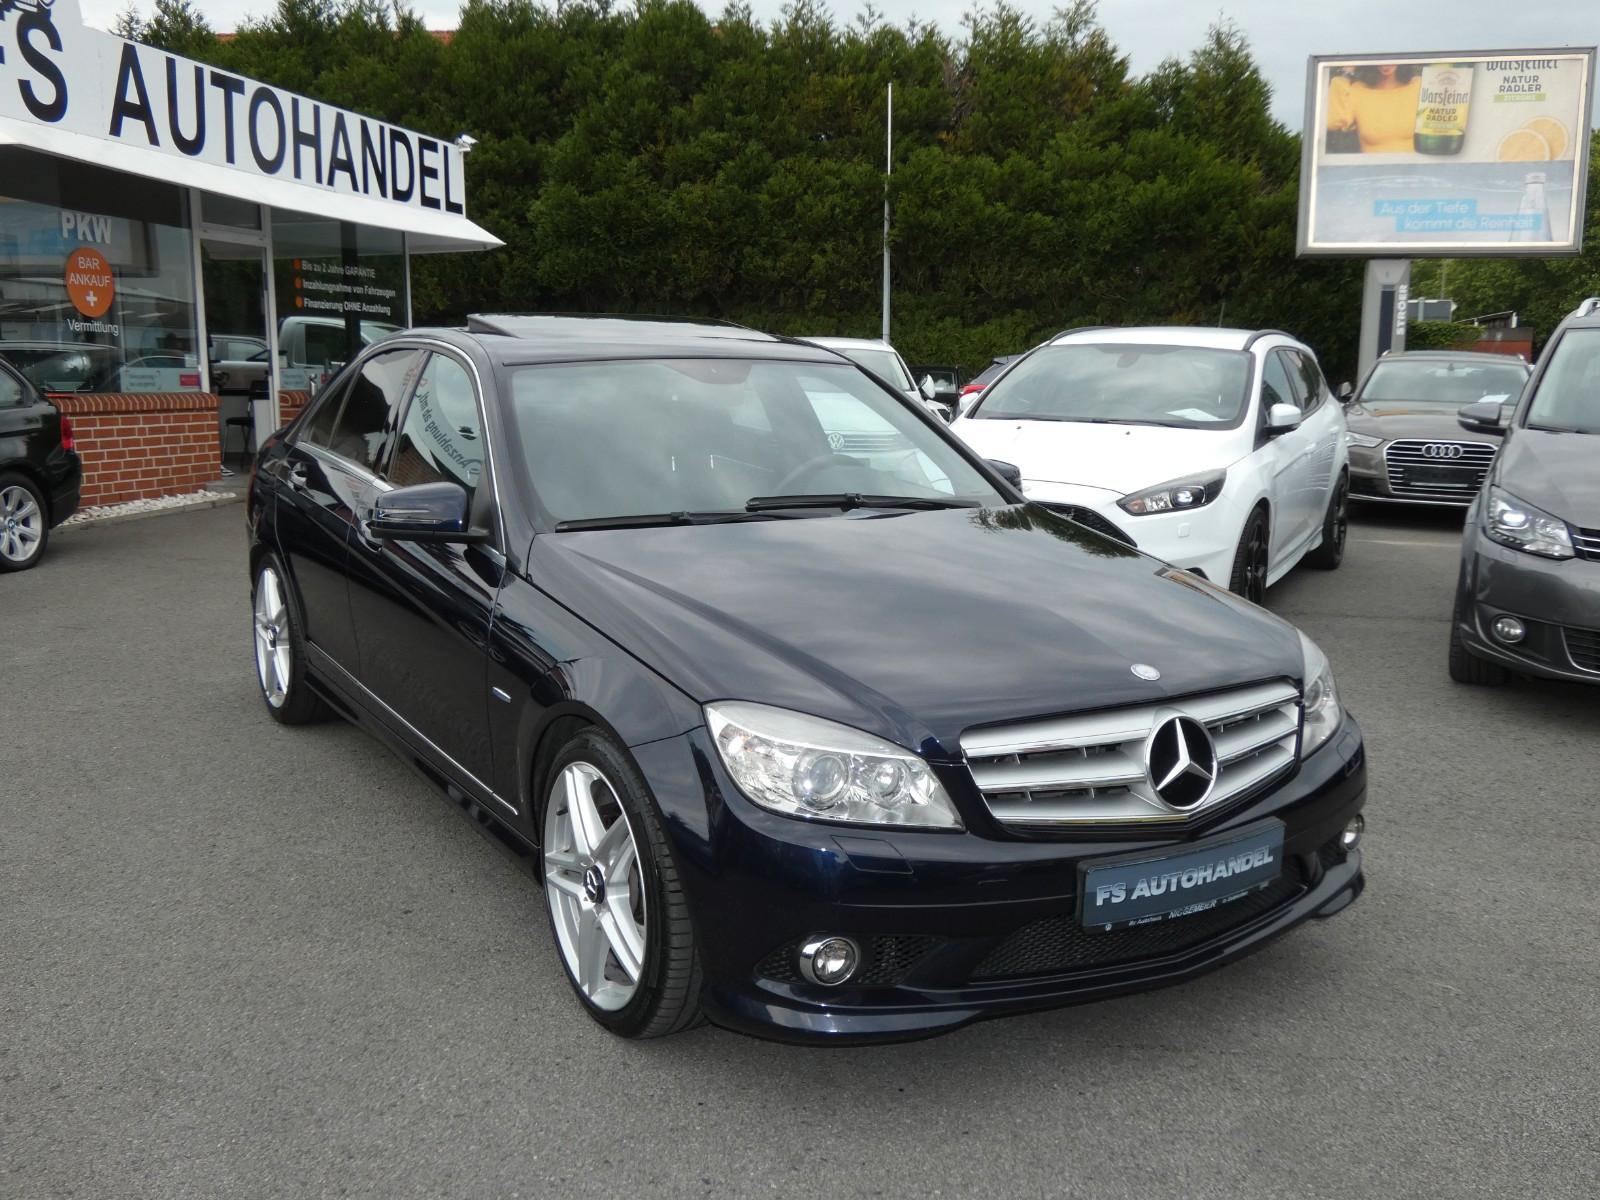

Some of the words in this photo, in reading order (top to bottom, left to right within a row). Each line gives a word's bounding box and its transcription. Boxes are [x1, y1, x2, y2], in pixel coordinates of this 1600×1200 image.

[1503, 75, 1540, 84] NATUR
[1499, 84, 1542, 93] RADLER
[109, 42, 463, 215] AUTOHANDEL
[1380, 203, 1404, 214] Aus
[1408, 202, 1431, 214] der
[1437, 201, 1469, 214] Tiefe
[61, 211, 112, 244] PKW
[78, 256, 100, 270] BAR
[69, 272, 110, 288] ANKAUF
[67, 318, 119, 336] Vermittlung
[1096, 882, 1127, 906] FS
[1131, 845, 1273, 900] AUTOHANDEL
